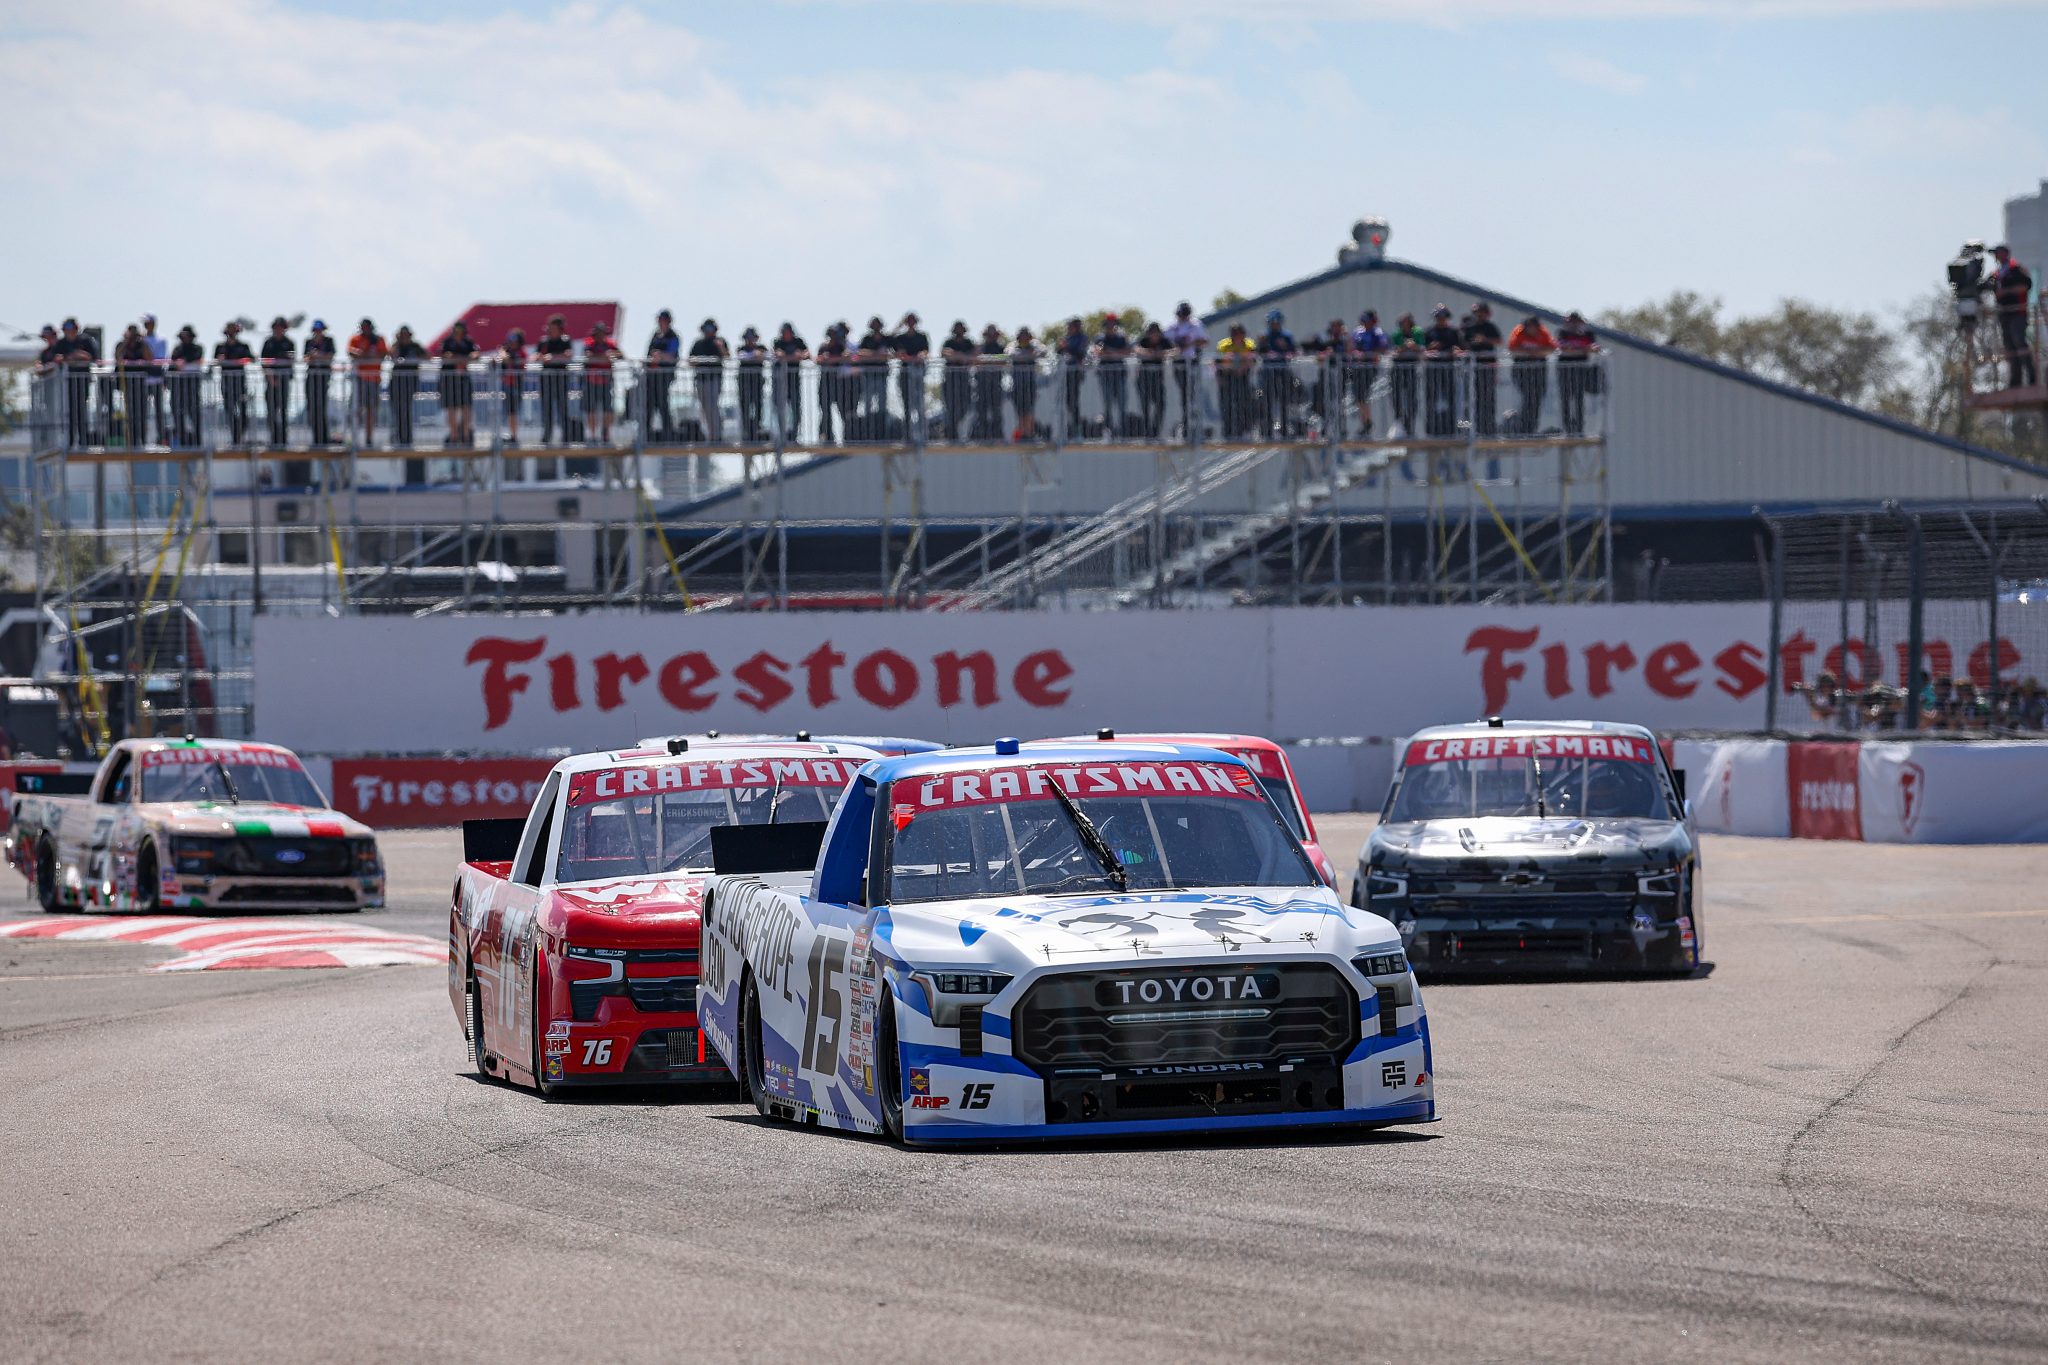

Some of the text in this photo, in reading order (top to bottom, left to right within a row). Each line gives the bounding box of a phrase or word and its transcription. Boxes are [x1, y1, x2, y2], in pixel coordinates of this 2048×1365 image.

[466, 635, 1074, 731] Firestone
[1464, 625, 2022, 716] Firestone
[1425, 737, 1634, 760] CRAFTSMAN
[353, 774, 543, 813] Fireston
[920, 767, 1236, 807] CRAFTSMAN
[1115, 976, 1263, 1004] TOYOTA
[801, 934, 848, 1076] 15
[546, 1040, 568, 1051] ARP
[582, 1039, 612, 1065] 76
[1128, 1062, 1264, 1075] TUNDRA
[911, 1096, 950, 1108] ARP
[959, 1084, 995, 1110] 15
